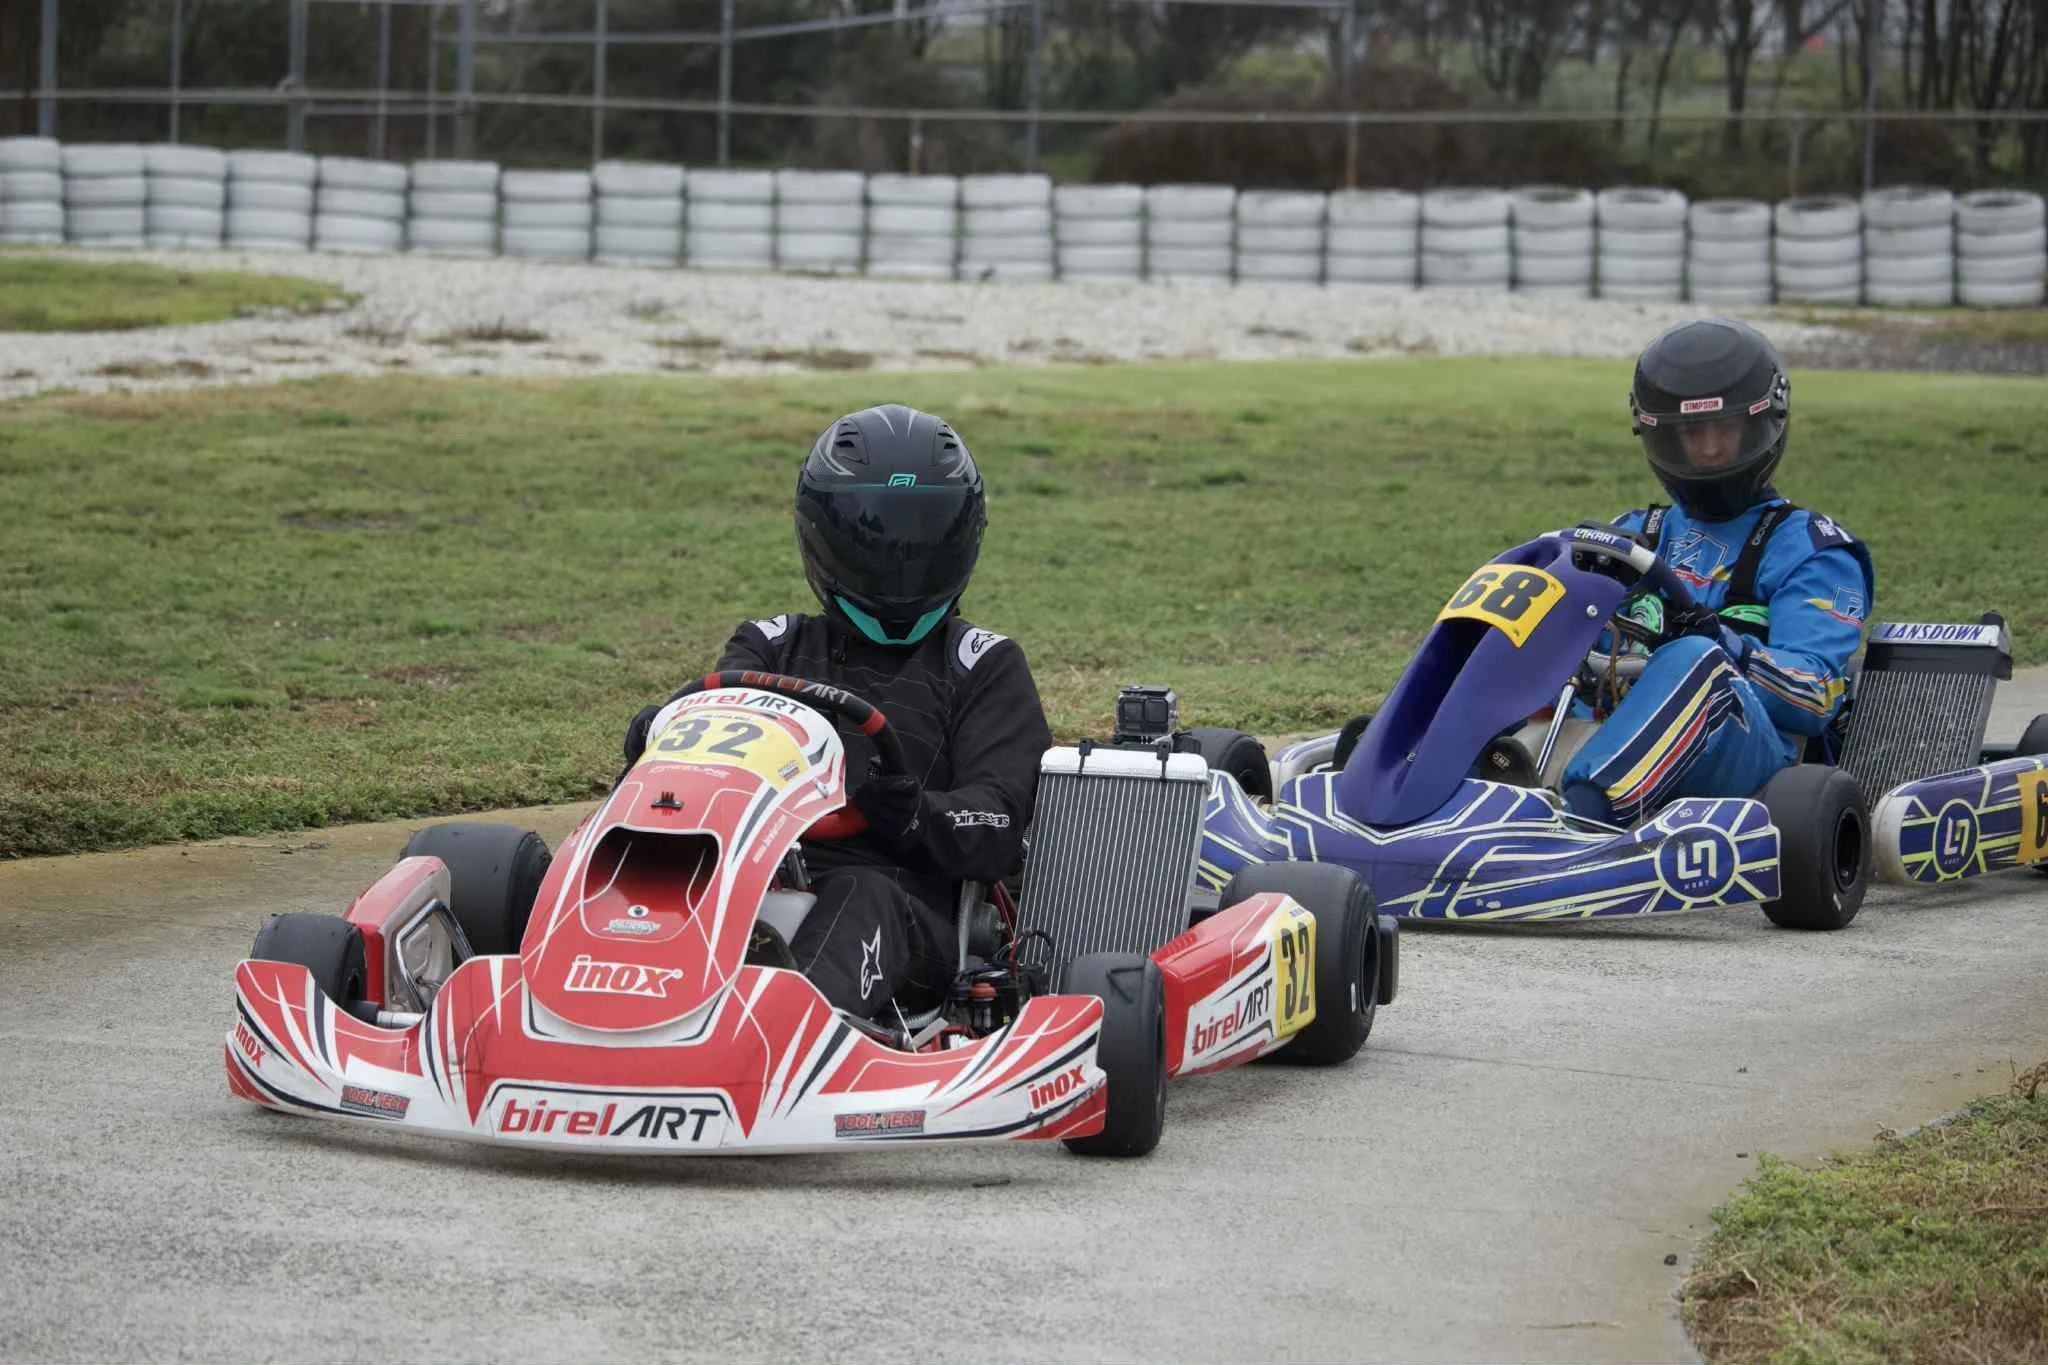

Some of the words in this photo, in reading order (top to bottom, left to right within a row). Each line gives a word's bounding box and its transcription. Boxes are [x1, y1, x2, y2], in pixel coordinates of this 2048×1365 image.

[1684, 400, 1720, 412] SIMPSON
[1450, 571, 1548, 621] 68
[1884, 624, 1984, 641] LANSDOWN
[676, 692, 806, 715] birelART
[741, 671, 856, 704] birelART
[657, 718, 763, 759] 32
[565, 954, 684, 998] inox
[1281, 922, 1312, 1020] 32
[1192, 977, 1274, 1057] birelART
[234, 1014, 270, 1069] inox
[1027, 1062, 1088, 1112] inox
[500, 1098, 721, 1142] birelART
